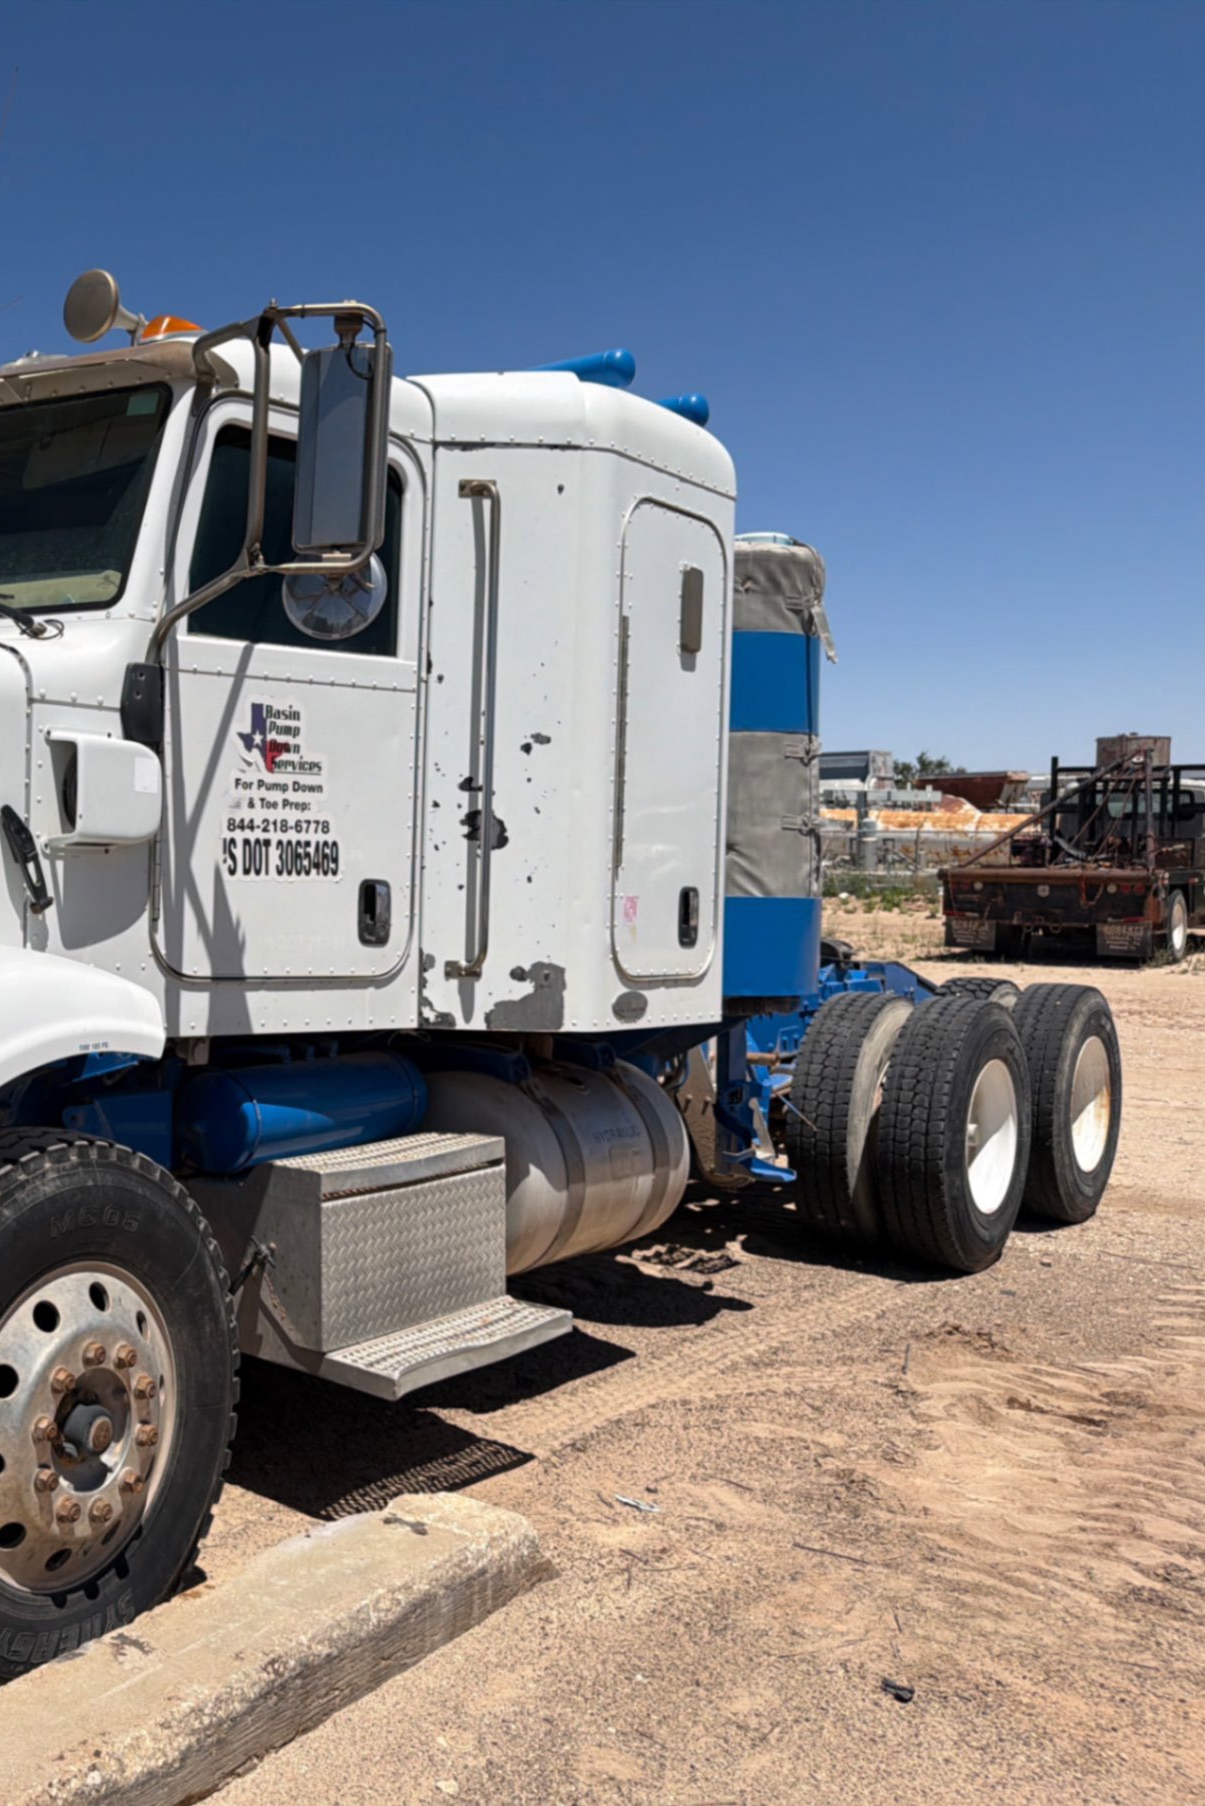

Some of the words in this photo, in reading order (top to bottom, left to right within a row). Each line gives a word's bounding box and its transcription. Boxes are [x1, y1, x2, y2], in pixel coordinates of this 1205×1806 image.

[265, 705, 301, 721] Basin
[268, 720, 301, 739] Pump
[268, 739, 301, 755] Down
[271, 755, 323, 773] Services
[234, 778, 254, 790] For
[257, 779, 289, 794] Pump
[292, 781, 324, 793] Down
[247, 797, 256, 809] &
[259, 798, 279, 810] Toe
[281, 798, 311, 813] Prep:
[226, 817, 330, 834] 844-218-6778
[242, 837, 271, 876] DOT
[275, 838, 339, 877] 3065469
